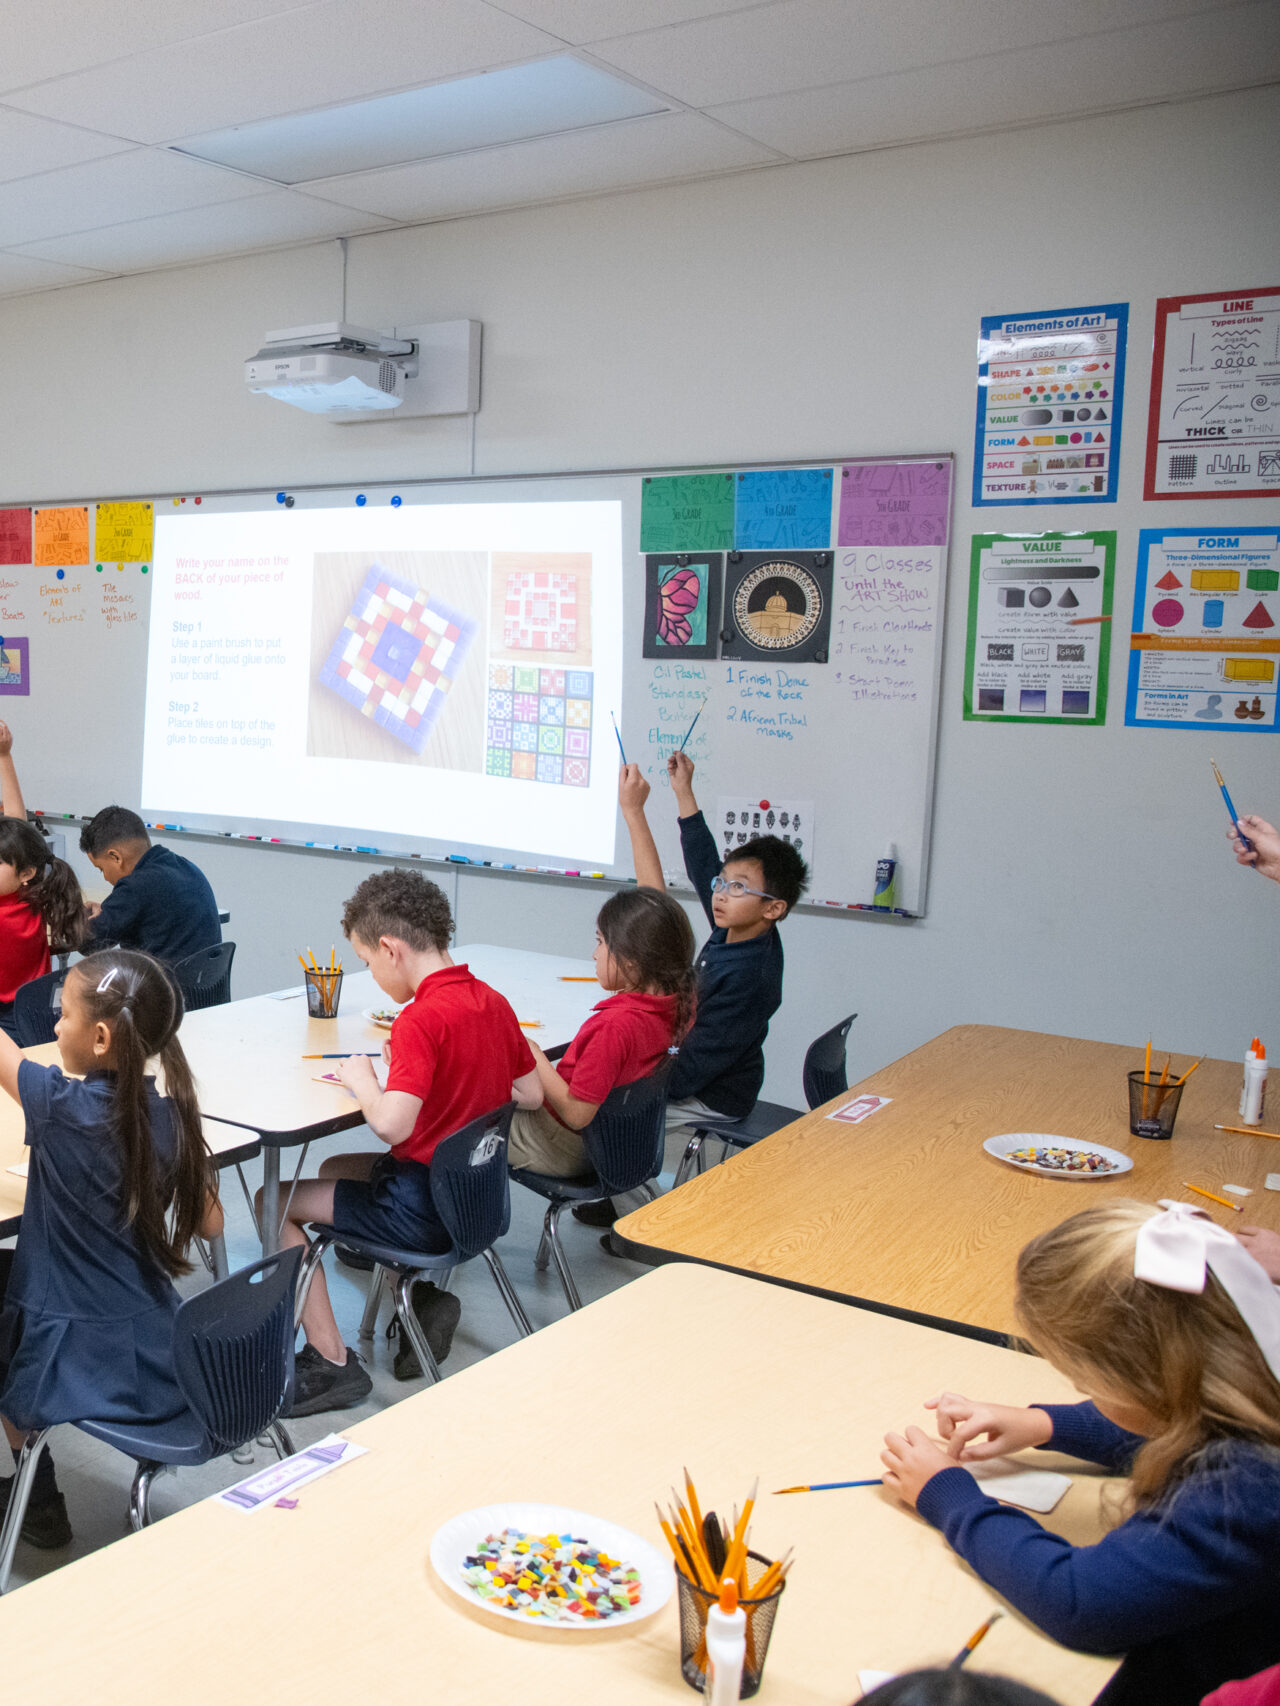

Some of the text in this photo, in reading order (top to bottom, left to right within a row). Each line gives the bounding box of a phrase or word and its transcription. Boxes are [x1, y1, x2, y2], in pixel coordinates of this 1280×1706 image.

[1223, 300, 1254, 312] LINE
[1005, 315, 1102, 334] Elements of Art
[1211, 319, 1236, 328] Types
[992, 370, 1022, 379] SHAPE
[990, 392, 1021, 402] COLOR
[990, 416, 1018, 424] VALUE
[1186, 426, 1226, 436] THICK
[1248, 424, 1274, 433] THIN
[988, 438, 1015, 447] FORM
[986, 461, 1014, 470] SPACE
[985, 483, 1026, 492] TEXTURE
[1022, 542, 1062, 552] VALUE
[1198, 538, 1240, 548] FORM
[176, 556, 289, 570] Write your name on the
[842, 552, 933, 573] 9 Classes
[175, 570, 284, 586] BACK of your piece of
[844, 578, 905, 591] Until the
[40, 584, 82, 597] Elements of
[102, 583, 117, 593] Tile
[174, 590, 204, 600] wood.
[850, 588, 928, 602] ART SHOW
[101, 606, 119, 615] with
[172, 620, 202, 634] Step 1
[852, 622, 880, 632] Finish
[172, 638, 282, 650] Use a paint brush to put
[989, 648, 1013, 656] BLACK
[170, 652, 287, 668] a layer of liquid glue onto
[170, 670, 222, 684] your board.
[674, 664, 706, 680] Pastel
[738, 670, 772, 687] Finish
[776, 669, 809, 688] Dome
[740, 687, 803, 700] of the Rock
[168, 700, 200, 715] Step 2
[168, 716, 276, 732] Place tiles on top of the
[740, 709, 776, 726] African
[778, 712, 808, 727] Tribal
[166, 733, 274, 749] glue to create a design.
[482, 1136, 496, 1157] 16
